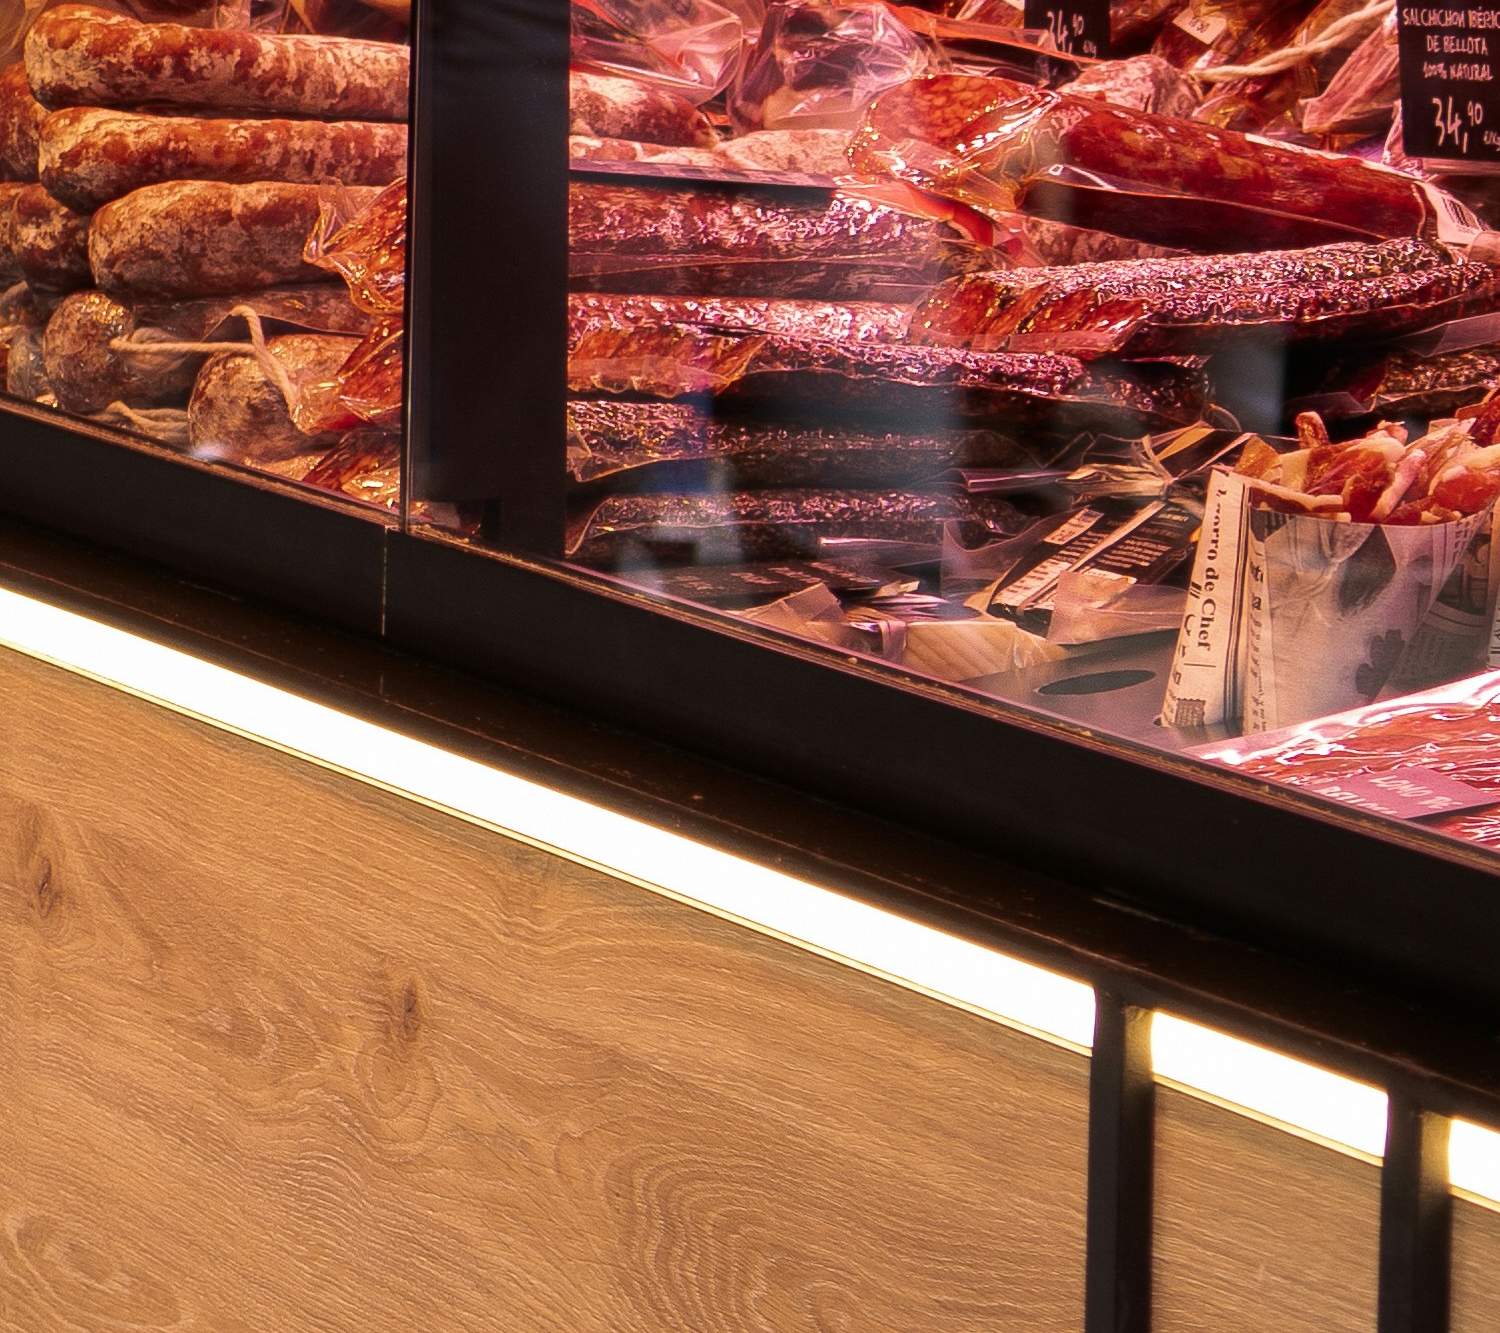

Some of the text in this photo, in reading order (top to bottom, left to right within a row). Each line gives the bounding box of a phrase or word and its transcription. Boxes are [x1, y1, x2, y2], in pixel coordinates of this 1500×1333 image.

[1426, 34, 1489, 56] DE BELLOTA
[1449, 63, 1494, 82] NATURAL
[1197, 596, 1218, 653] Chef
[1368, 773, 1432, 801] LOMO
